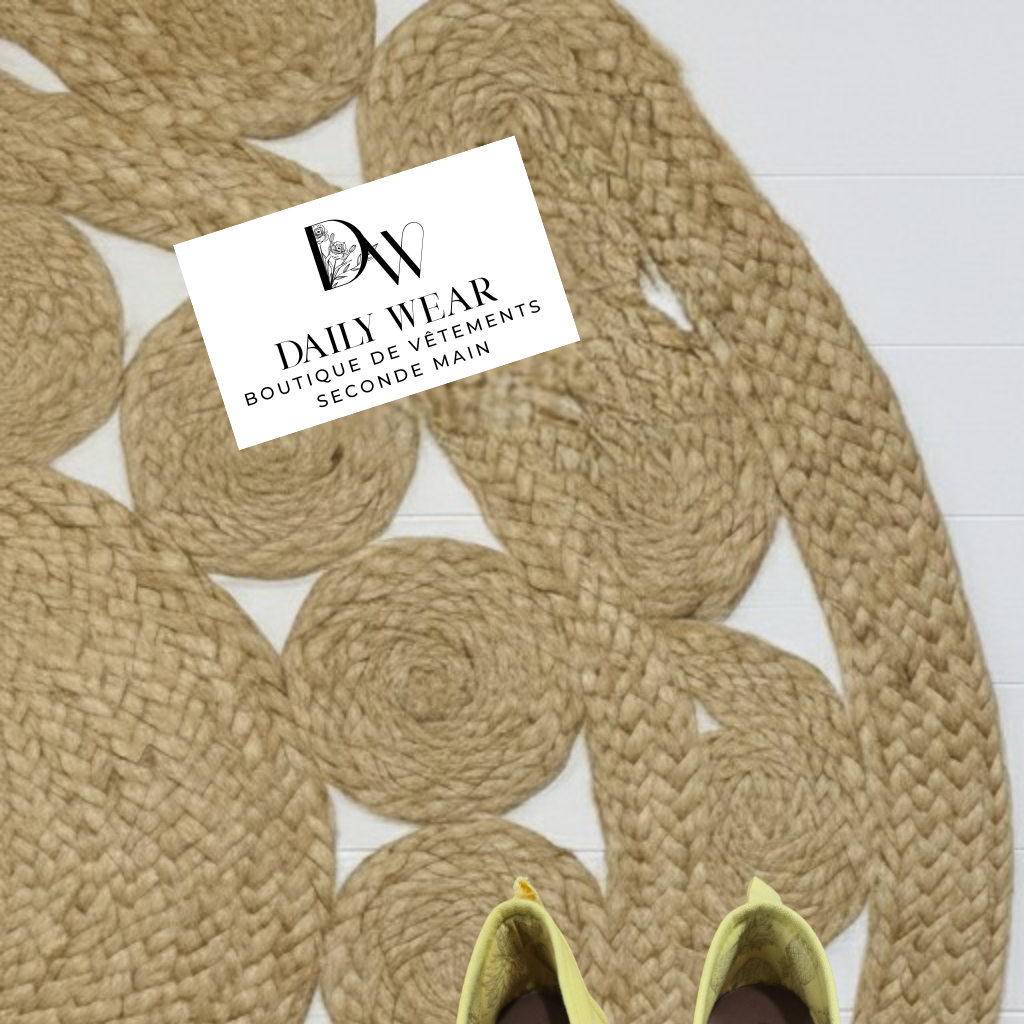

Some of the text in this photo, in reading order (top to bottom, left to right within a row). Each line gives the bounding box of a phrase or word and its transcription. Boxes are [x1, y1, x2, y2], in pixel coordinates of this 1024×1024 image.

[243, 299, 542, 407] BOUTIQUE DE VÊTEMENTS
[273, 276, 499, 371] DAILY WEAR
[316, 340, 491, 408] SECONDE MAIN
